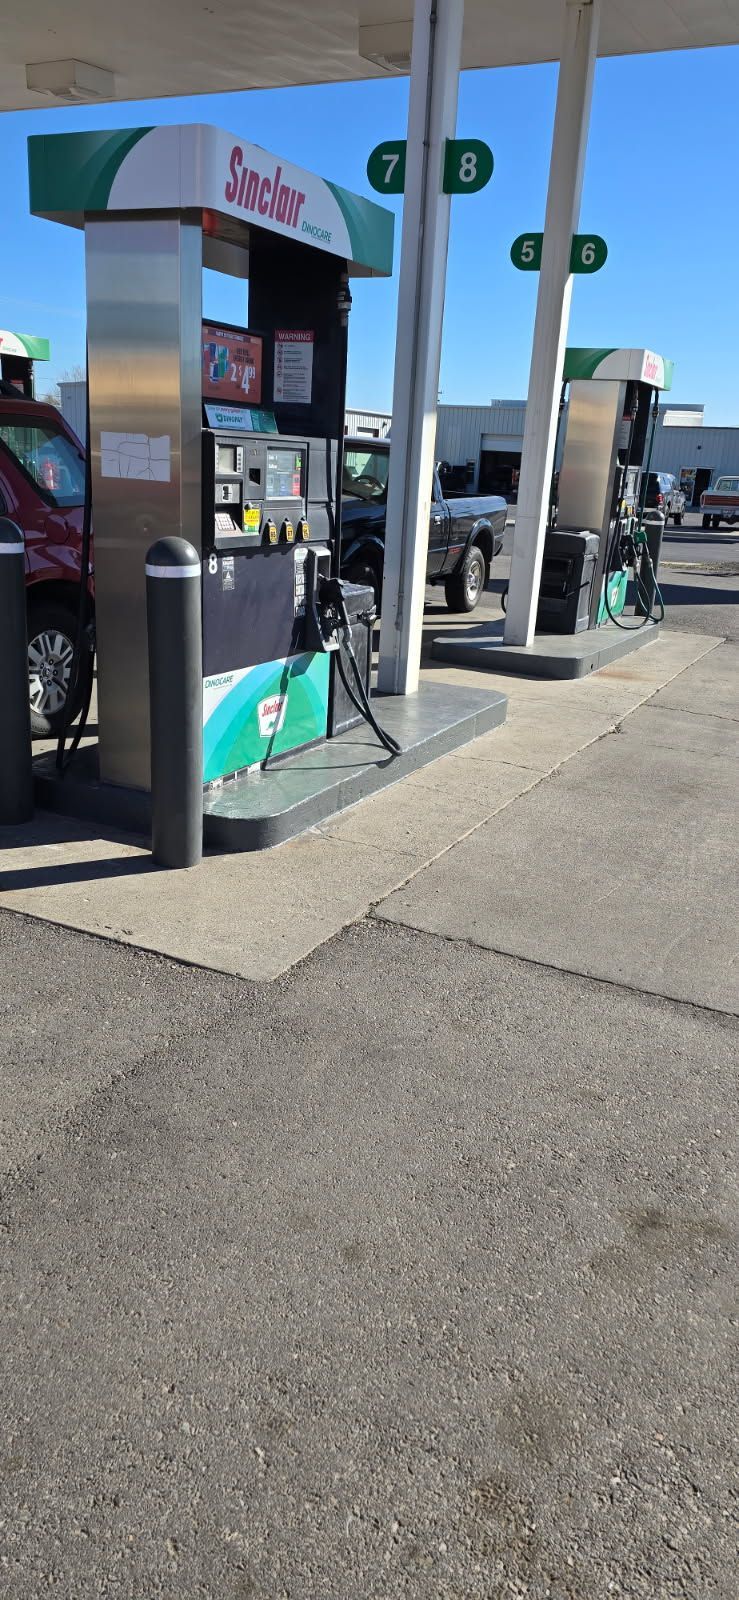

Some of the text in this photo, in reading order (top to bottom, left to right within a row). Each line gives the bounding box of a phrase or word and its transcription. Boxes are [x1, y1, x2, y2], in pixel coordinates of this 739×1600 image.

[382, 152, 477, 183] 7 8
[224, 145, 306, 229] Sinclair
[301, 220, 332, 242] DINOCARE
[521, 241, 596, 265] 5 6
[278, 332, 311, 341] WARNING
[208, 553, 218, 575] 8
[204, 674, 234, 689] DINOCARE
